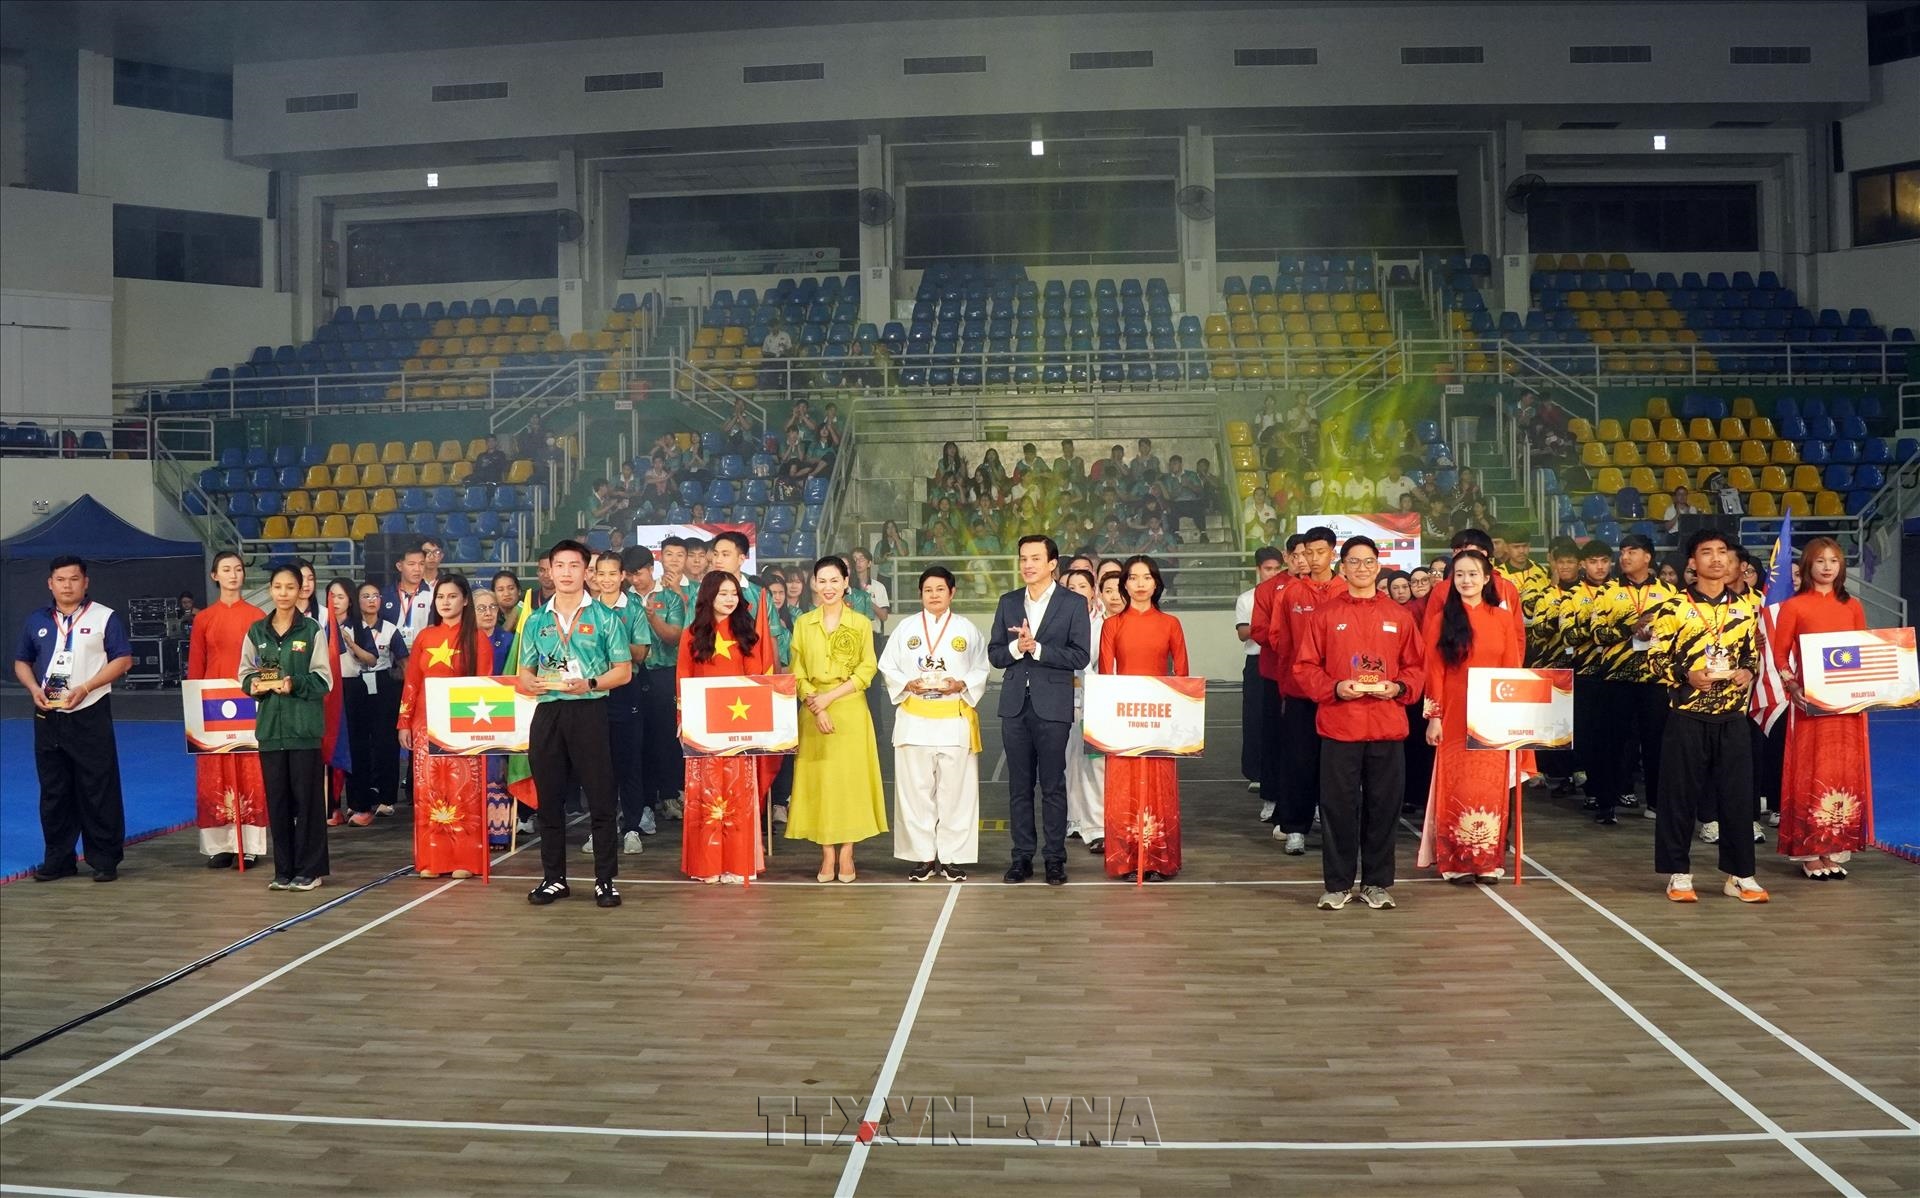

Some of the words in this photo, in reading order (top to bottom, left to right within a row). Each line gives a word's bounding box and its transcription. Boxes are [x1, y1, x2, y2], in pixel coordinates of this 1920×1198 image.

[261, 672, 278, 680] 2026
[1851, 690, 1876, 699] MALAYSIA
[1117, 702, 1171, 718] REFEREE
